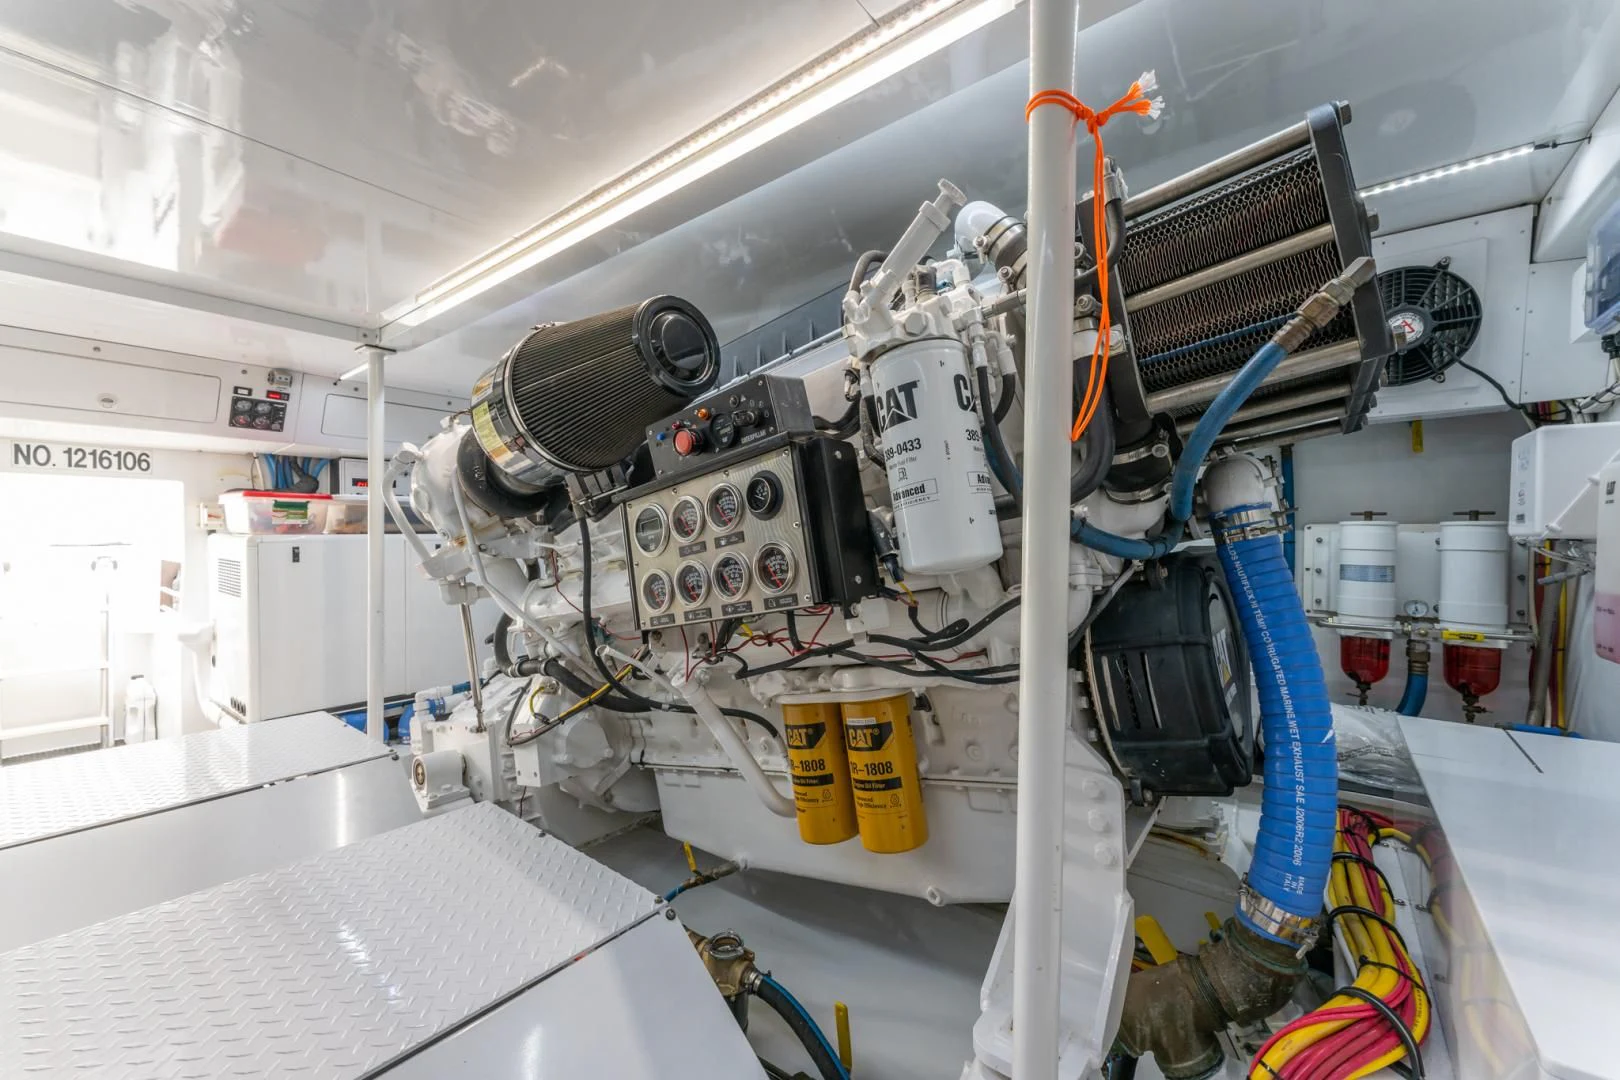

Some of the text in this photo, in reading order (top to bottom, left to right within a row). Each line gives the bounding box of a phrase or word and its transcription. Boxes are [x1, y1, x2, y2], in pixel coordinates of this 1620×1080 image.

[876, 380, 919, 433] CAT
[13, 443, 151, 472] NO. 1216106
[1253, 608, 1268, 630] TEMP
[1280, 685, 1296, 719] MARINE
[787, 728, 808, 747] CAT
[848, 728, 873, 748] CAT
[1287, 720, 1300, 740] WET
[791, 759, 826, 772] R-1808
[1291, 740, 1305, 784] EXHAUST
[1295, 784, 1305, 804] SAE
[1294, 806, 1305, 843] J2006R2
[1292, 844, 1303, 866] 2006
